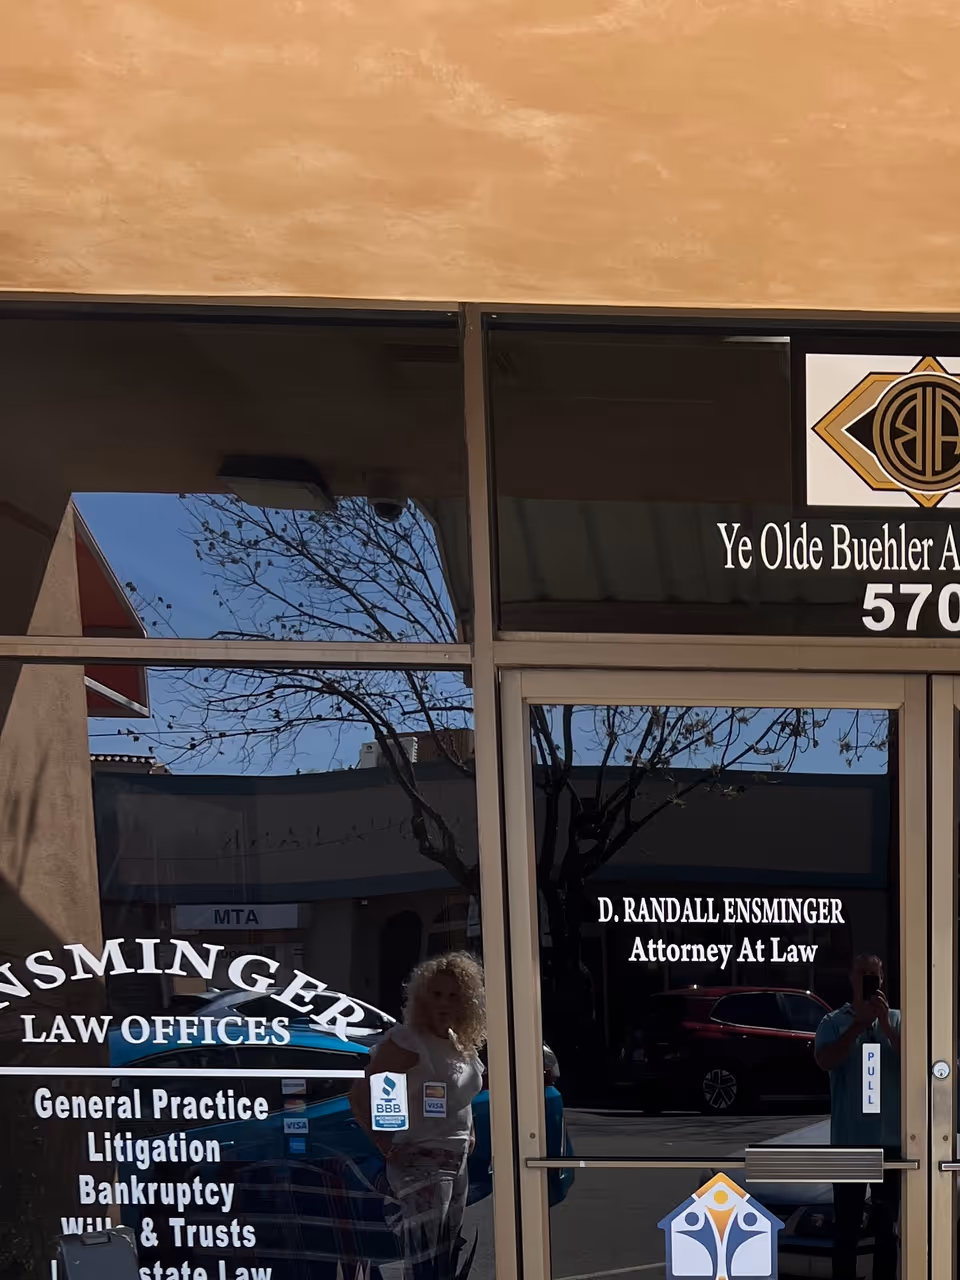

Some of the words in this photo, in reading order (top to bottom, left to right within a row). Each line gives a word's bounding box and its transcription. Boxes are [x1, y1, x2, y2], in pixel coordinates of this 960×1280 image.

[717, 522, 752, 569] Ye
[760, 522, 823, 570] Olde
[831, 523, 933, 571] Buehler
[597, 896, 619, 923] D.
[623, 896, 719, 923] RANDALL
[723, 897, 845, 924] ENSMINGER
[628, 936, 733, 970] Attorney
[737, 937, 765, 963] At
[770, 937, 818, 963] Law
[20, 1014, 113, 1044] LAW
[120, 1014, 291, 1046] OFFICES
[867, 1051, 875, 1105] PULL
[34, 1087, 142, 1119] General
[152, 1088, 269, 1121] Practice
[376, 1103, 402, 1114] BBB
[286, 1121, 308, 1130] VISA
[87, 1131, 221, 1170] Litigation
[78, 1174, 235, 1213] Bankruptcy
[60, 1217, 127, 1235] Will
[140, 1217, 159, 1248] &
[169, 1217, 256, 1248] Trusts
